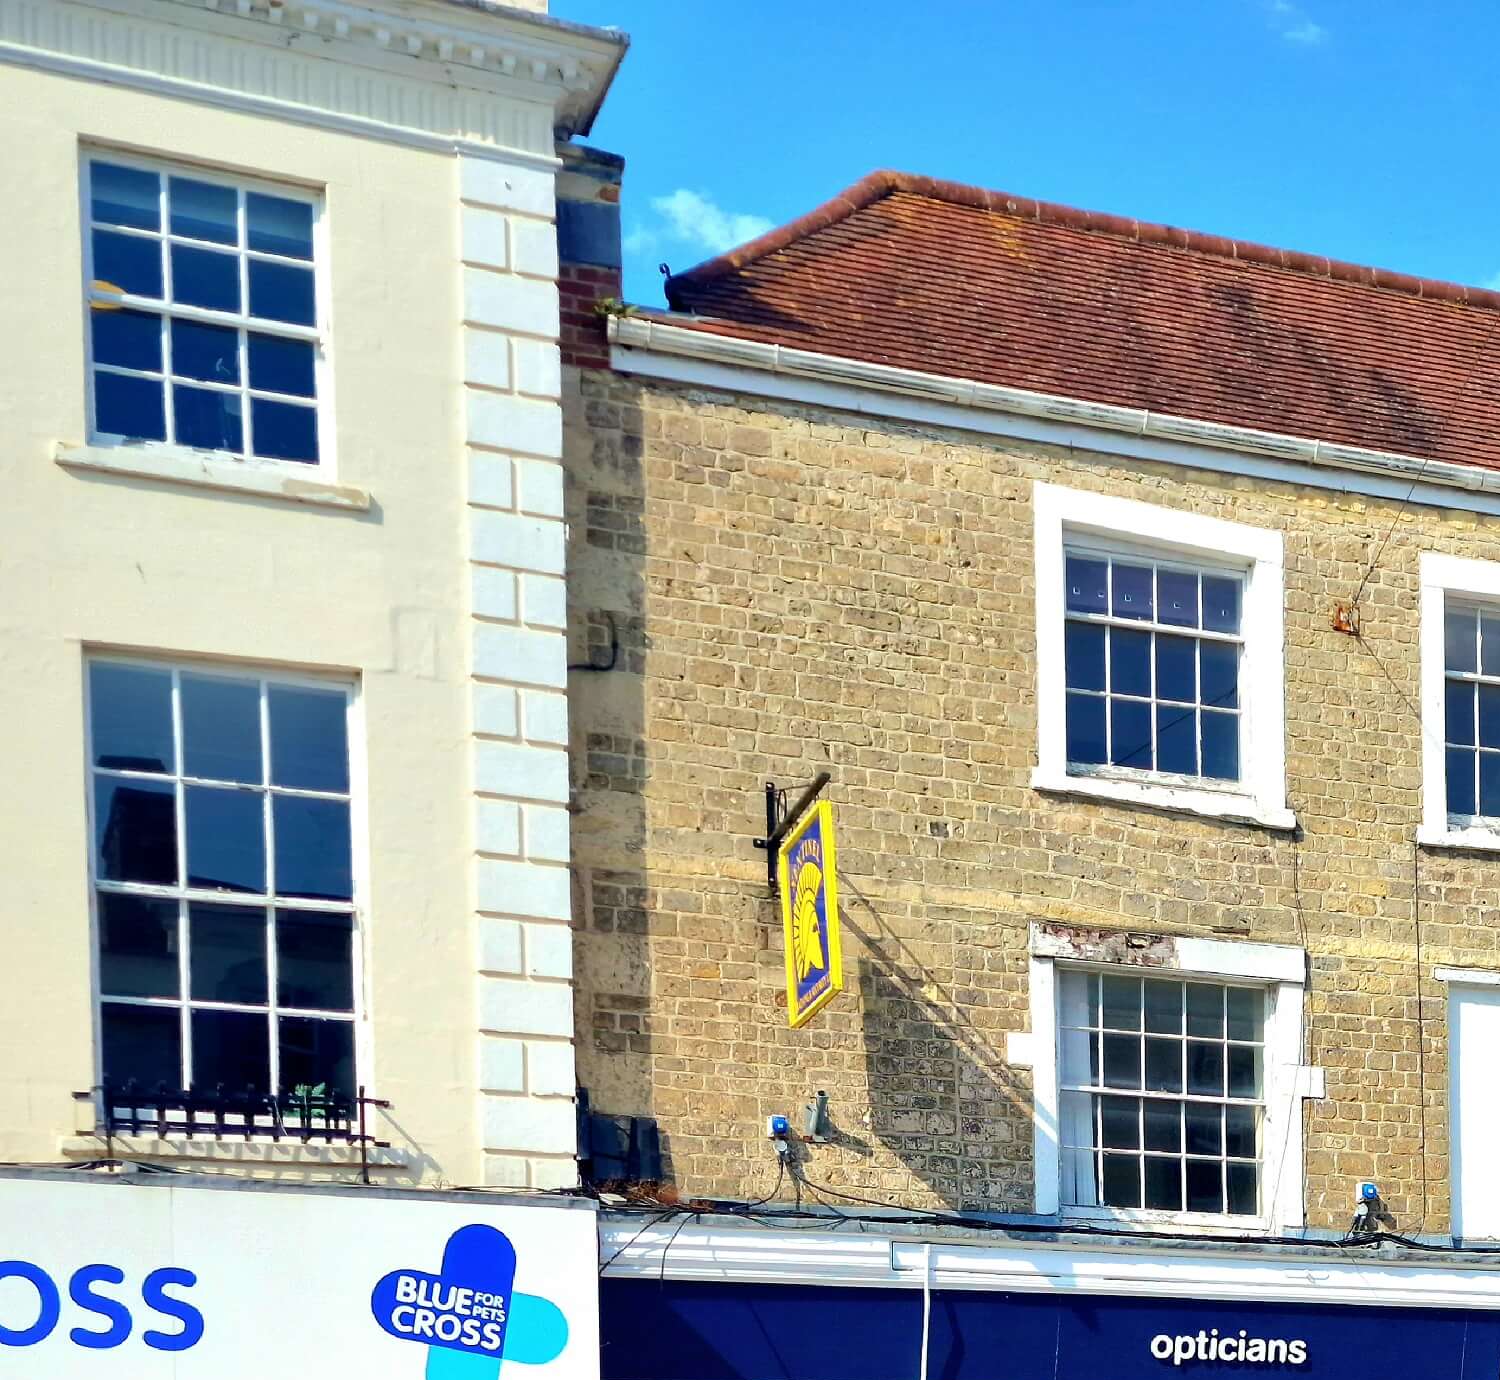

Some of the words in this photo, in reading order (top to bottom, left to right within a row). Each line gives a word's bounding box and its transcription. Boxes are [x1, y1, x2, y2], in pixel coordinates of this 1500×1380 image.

[396, 1275, 474, 1316] BLUE
[472, 1305, 506, 1323] PETS
[474, 1291, 504, 1308] FOR
[391, 1305, 501, 1350] CROSS
[1150, 1328, 1307, 1366] opticians
